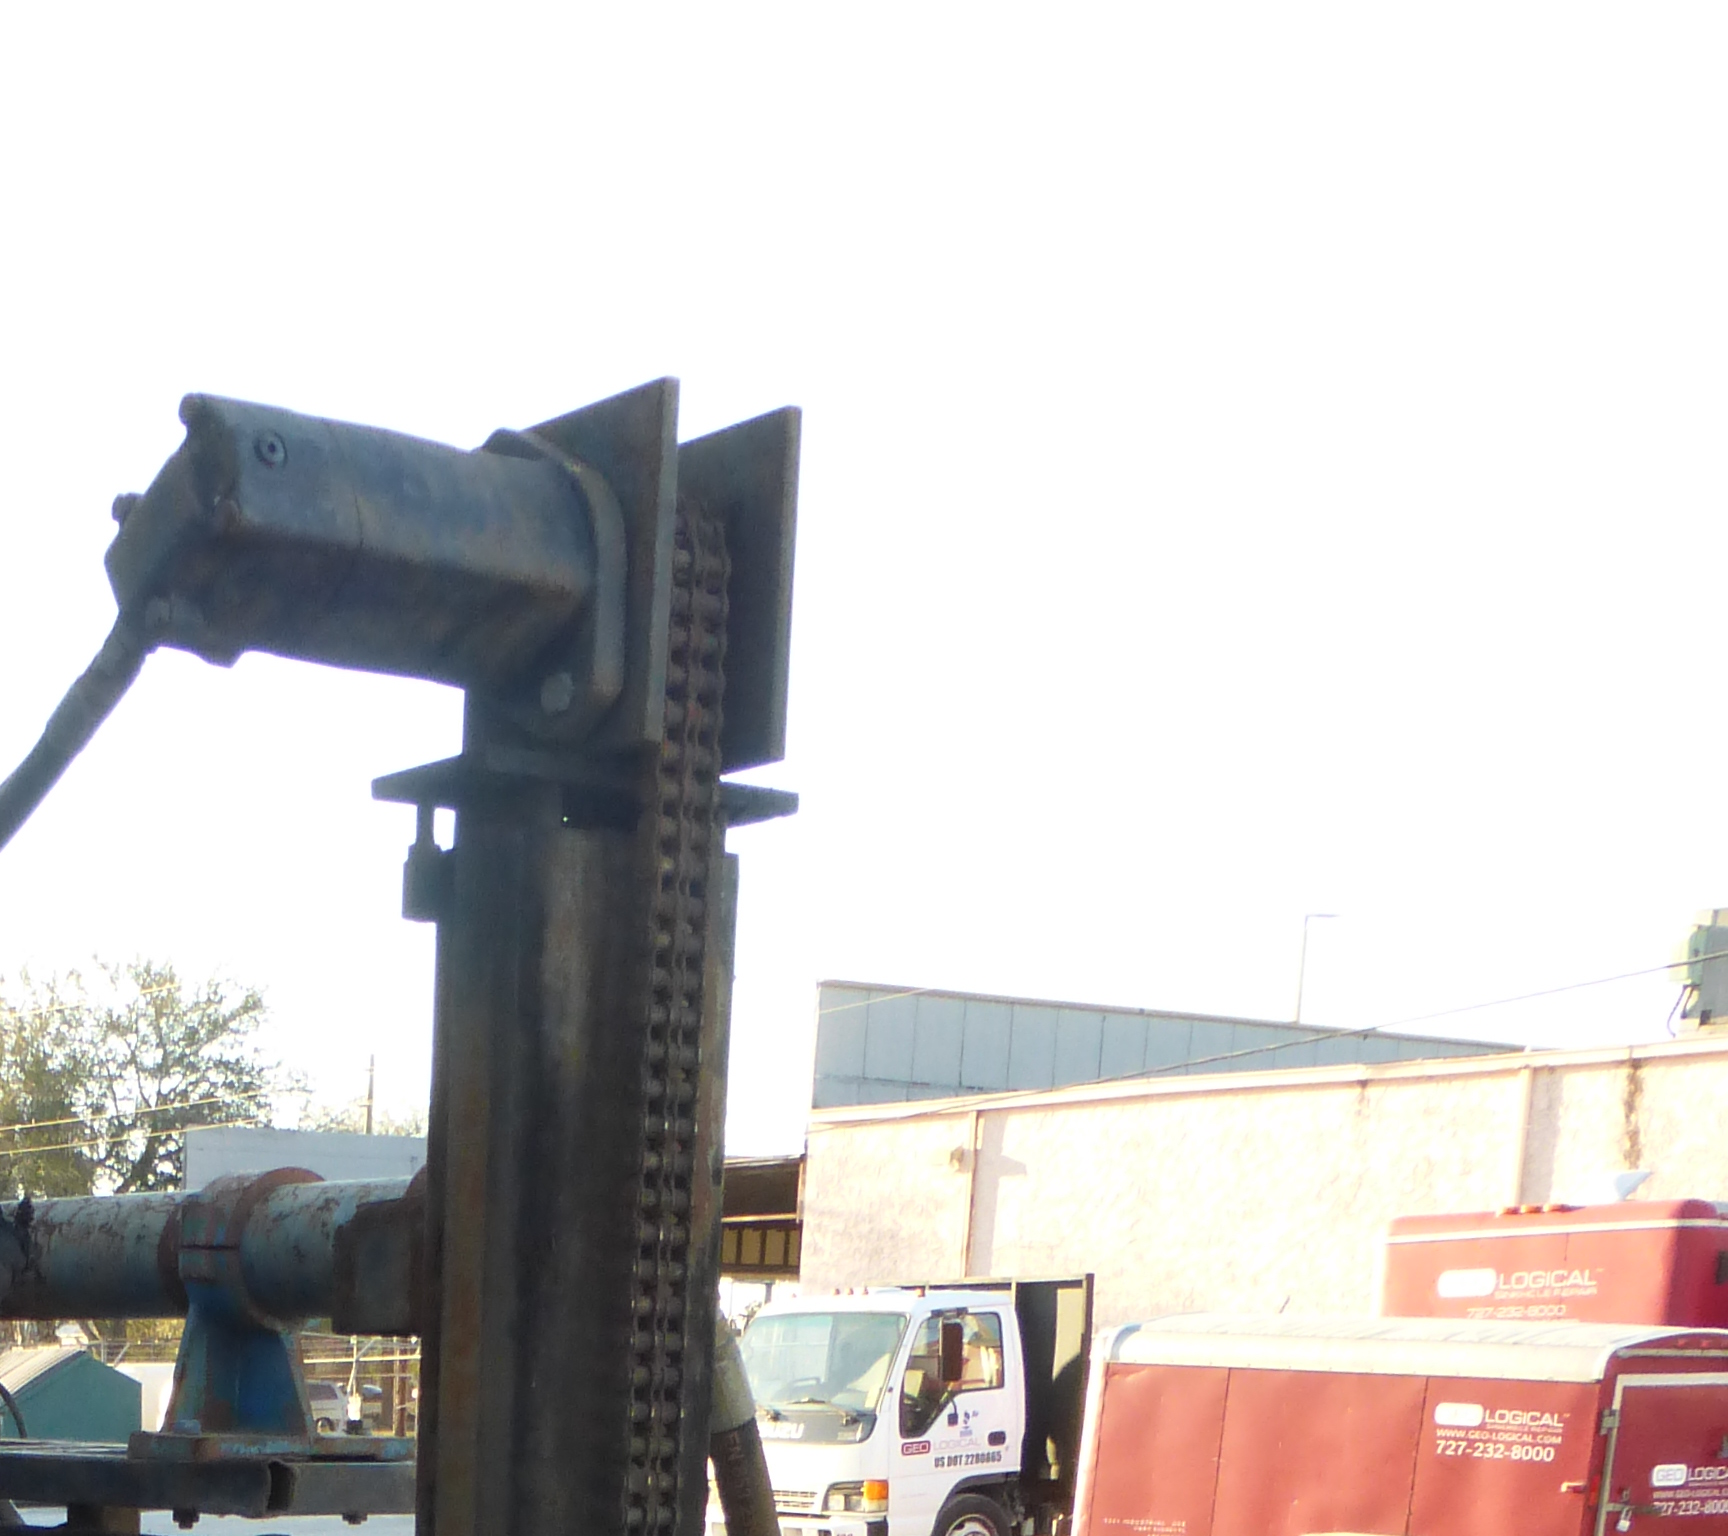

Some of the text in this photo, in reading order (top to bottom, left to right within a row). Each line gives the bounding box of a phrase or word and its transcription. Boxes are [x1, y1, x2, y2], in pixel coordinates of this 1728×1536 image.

[1499, 1269, 1598, 1289] LOGICAL
[1485, 1409, 1565, 1427] LOGICAL
[903, 1443, 929, 1454] GEO
[1436, 1440, 1555, 1462] 727-232-8000
